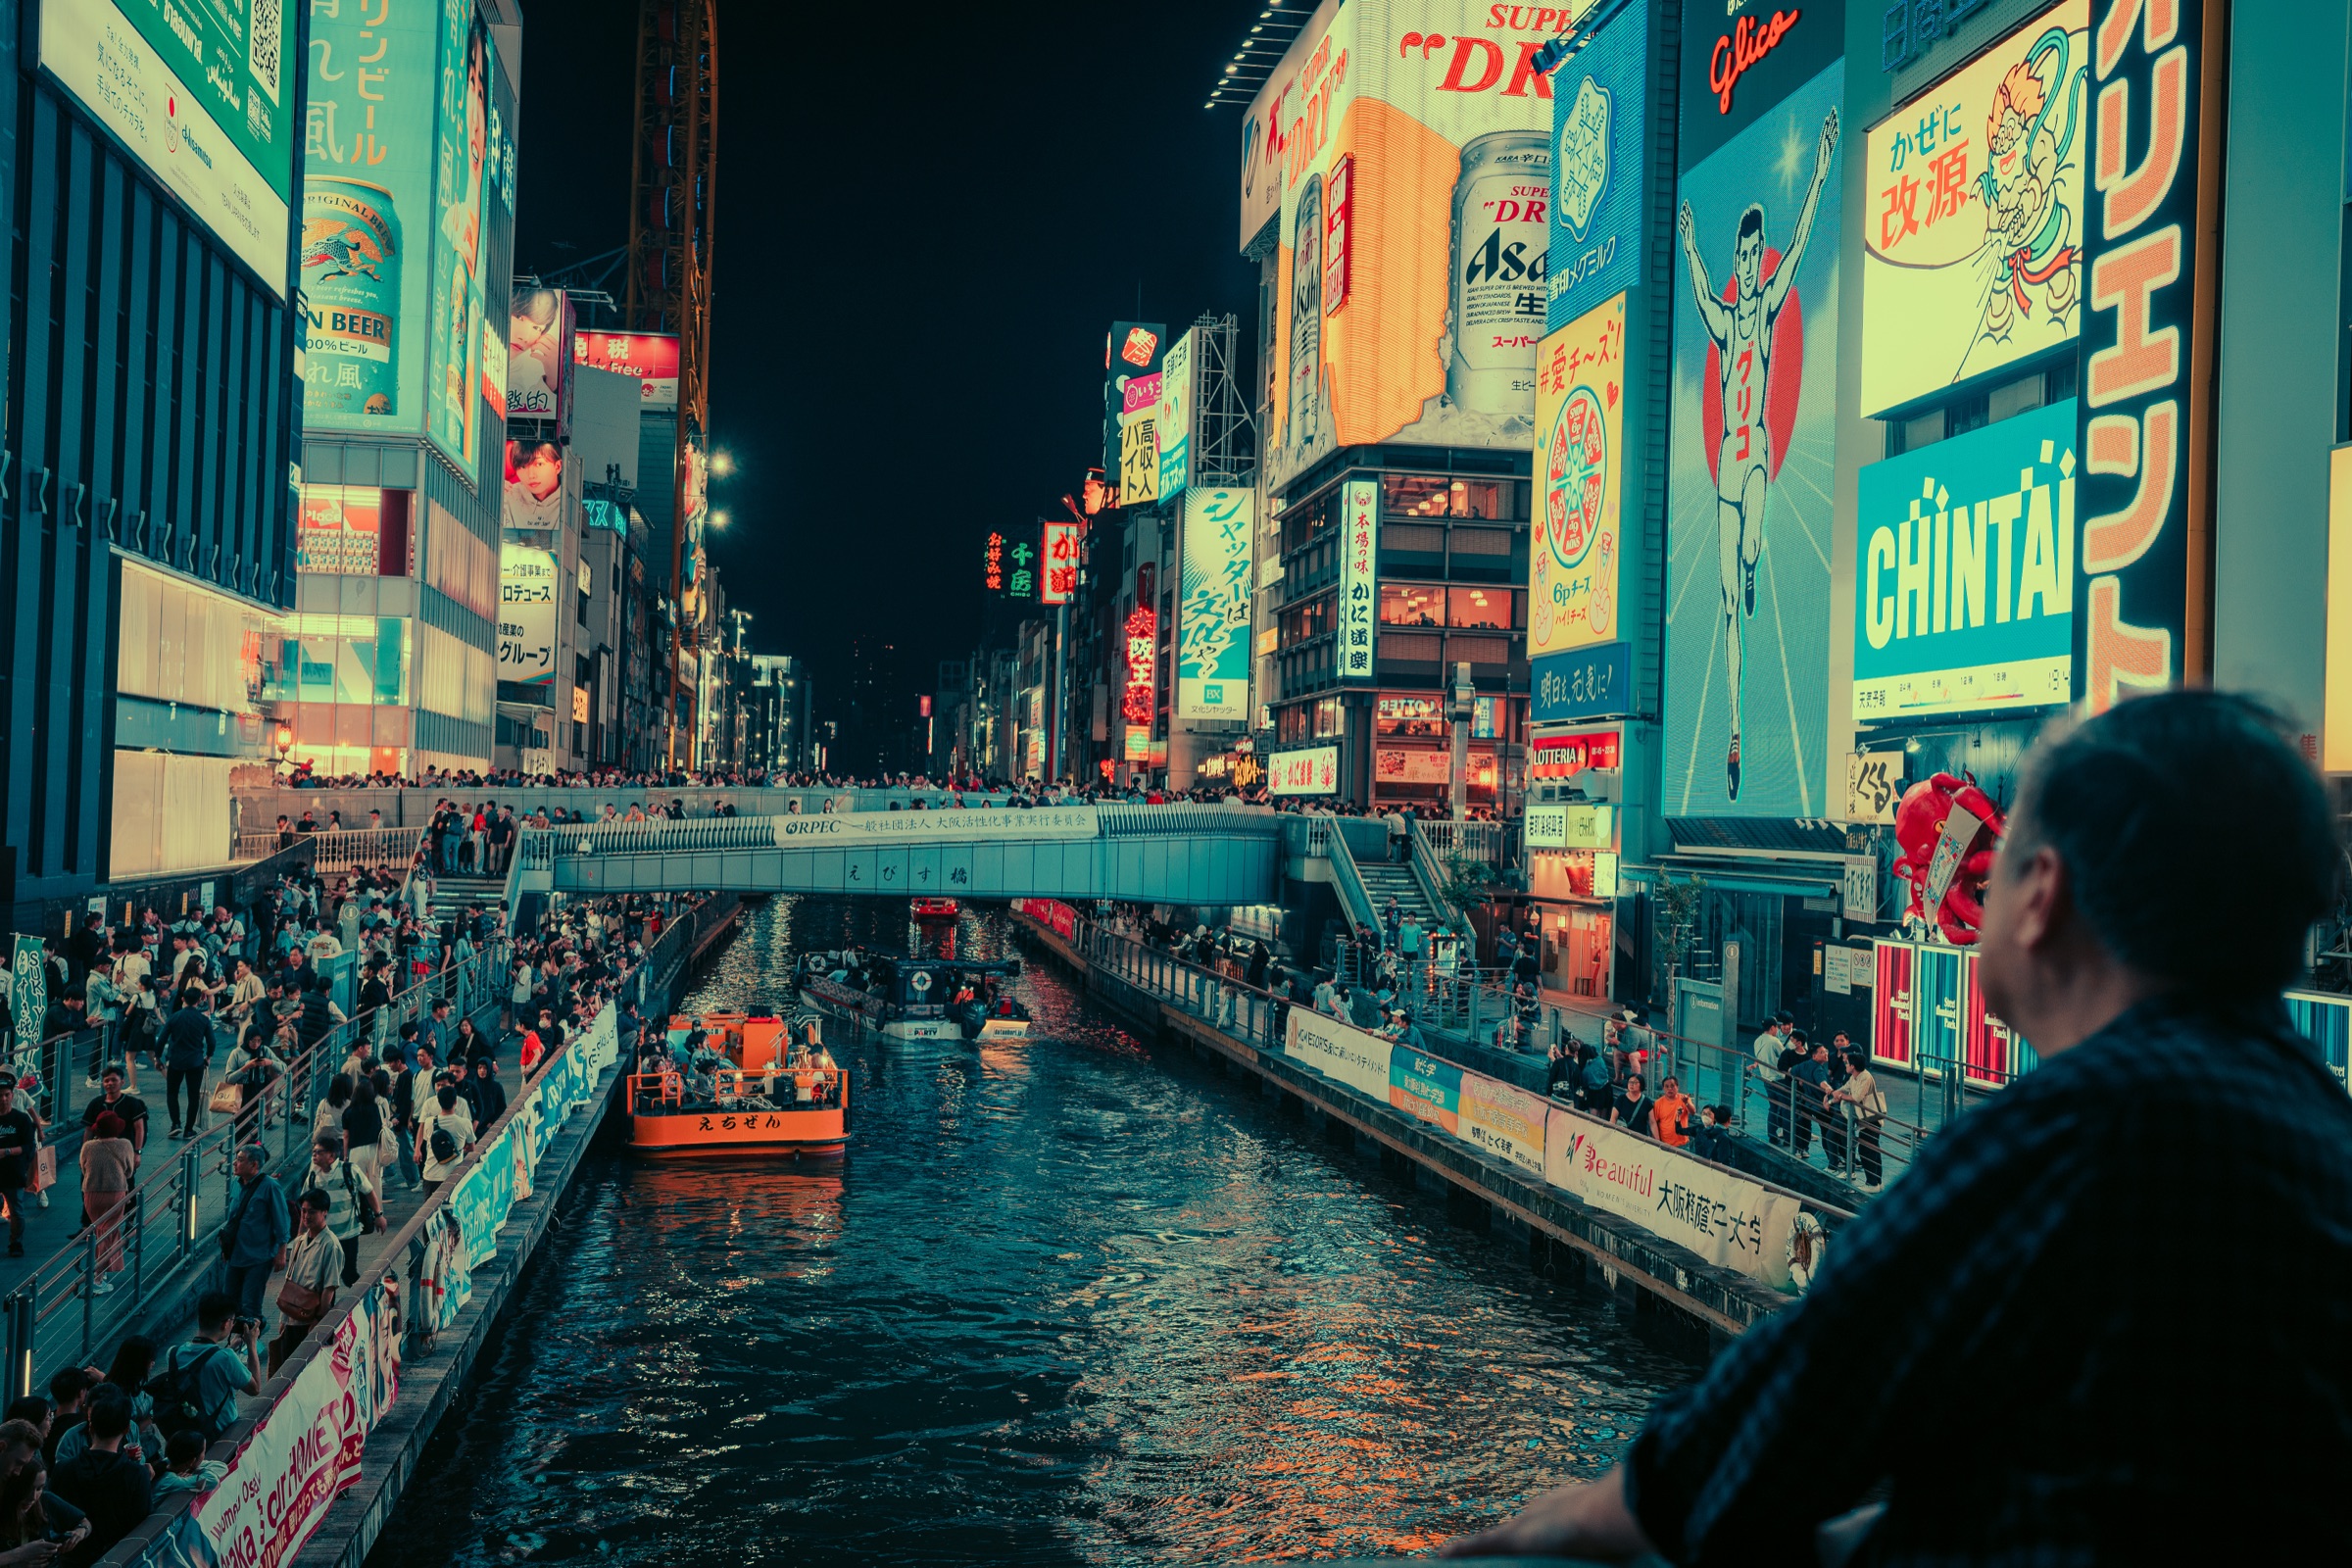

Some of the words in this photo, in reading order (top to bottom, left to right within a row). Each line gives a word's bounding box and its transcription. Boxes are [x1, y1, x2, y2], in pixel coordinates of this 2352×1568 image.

[1709, 9, 1800, 115] Glico
[1889, 102, 1963, 173] かぜに
[1510, 185, 1550, 199] SUPE
[1881, 138, 1970, 251] 改源
[303, 195, 368, 219] RIGINAL
[1548, 234, 1617, 302] 雪印メグミルク
[334, 285, 365, 297] refreshes
[1514, 292, 1547, 317] 生
[331, 312, 385, 340] BEER
[1492, 335, 1542, 348] スーパー
[611, 362, 643, 376] Free
[1736, 342, 1754, 464] グリコ
[1124, 421, 1141, 501] バイト
[1138, 418, 1155, 499] 高収入
[1353, 511, 1370, 575] 本場の味
[1864, 438, 2077, 650] CHINTAI
[500, 563, 551, 577] ー・介護事業まで
[1010, 542, 1034, 592] 千房
[499, 583, 551, 604] ロデュース
[497, 640, 552, 667] グループ
[1205, 689, 1222, 700] BX
[1534, 747, 1577, 766] LOTTERIA
[851, 816, 932, 833] 一般社団法人
[935, 812, 1088, 830] 大阪活性化事業実行委員会
[849, 863, 968, 885] えびす橋
[699, 1114, 781, 1131] えちぜん
